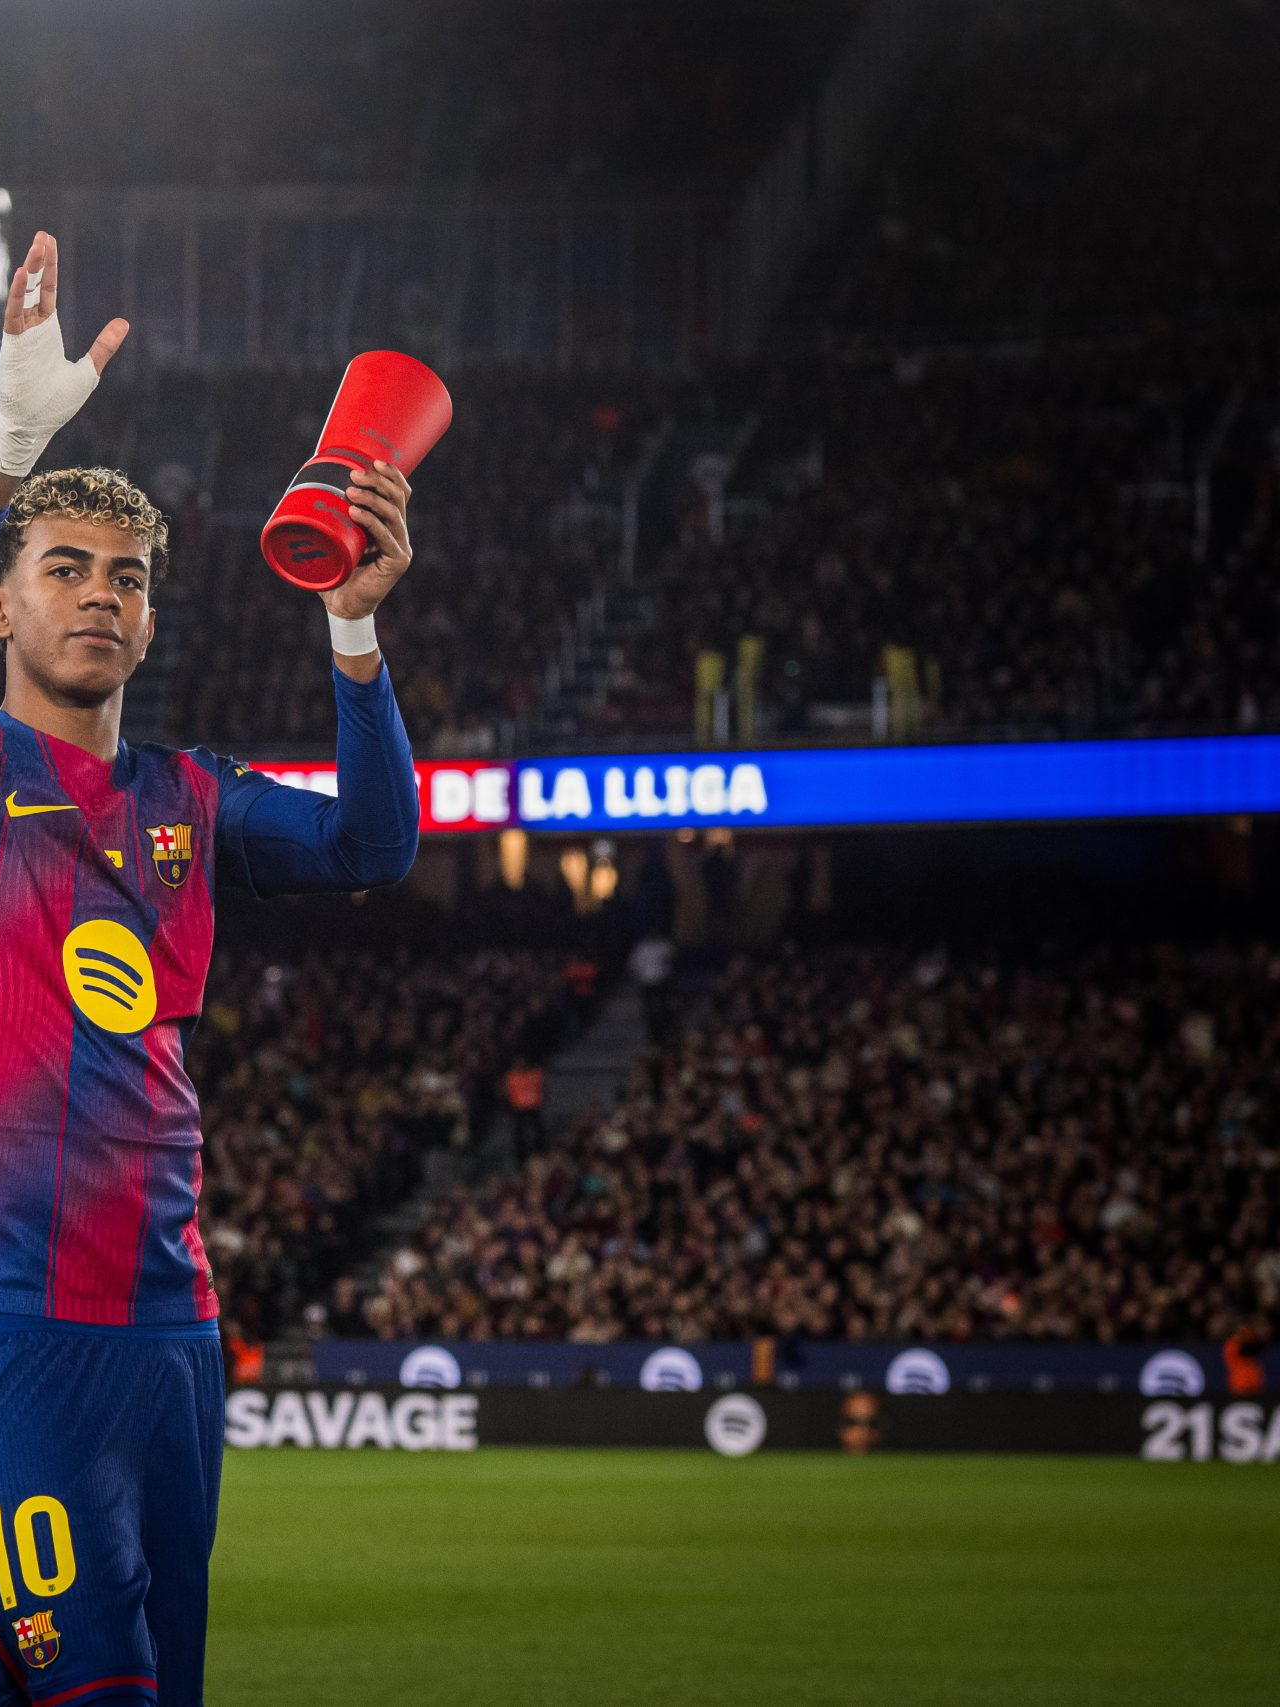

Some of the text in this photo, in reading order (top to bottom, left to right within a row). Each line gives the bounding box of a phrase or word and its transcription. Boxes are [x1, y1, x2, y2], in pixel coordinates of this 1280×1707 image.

[431, 769, 510, 823] DE
[519, 767, 593, 821] LA
[603, 763, 768, 819] LLIGA
[167, 850, 183, 859] FCB
[226, 1389, 479, 1450] SAVAGE
[1142, 1402, 1212, 1461] 21
